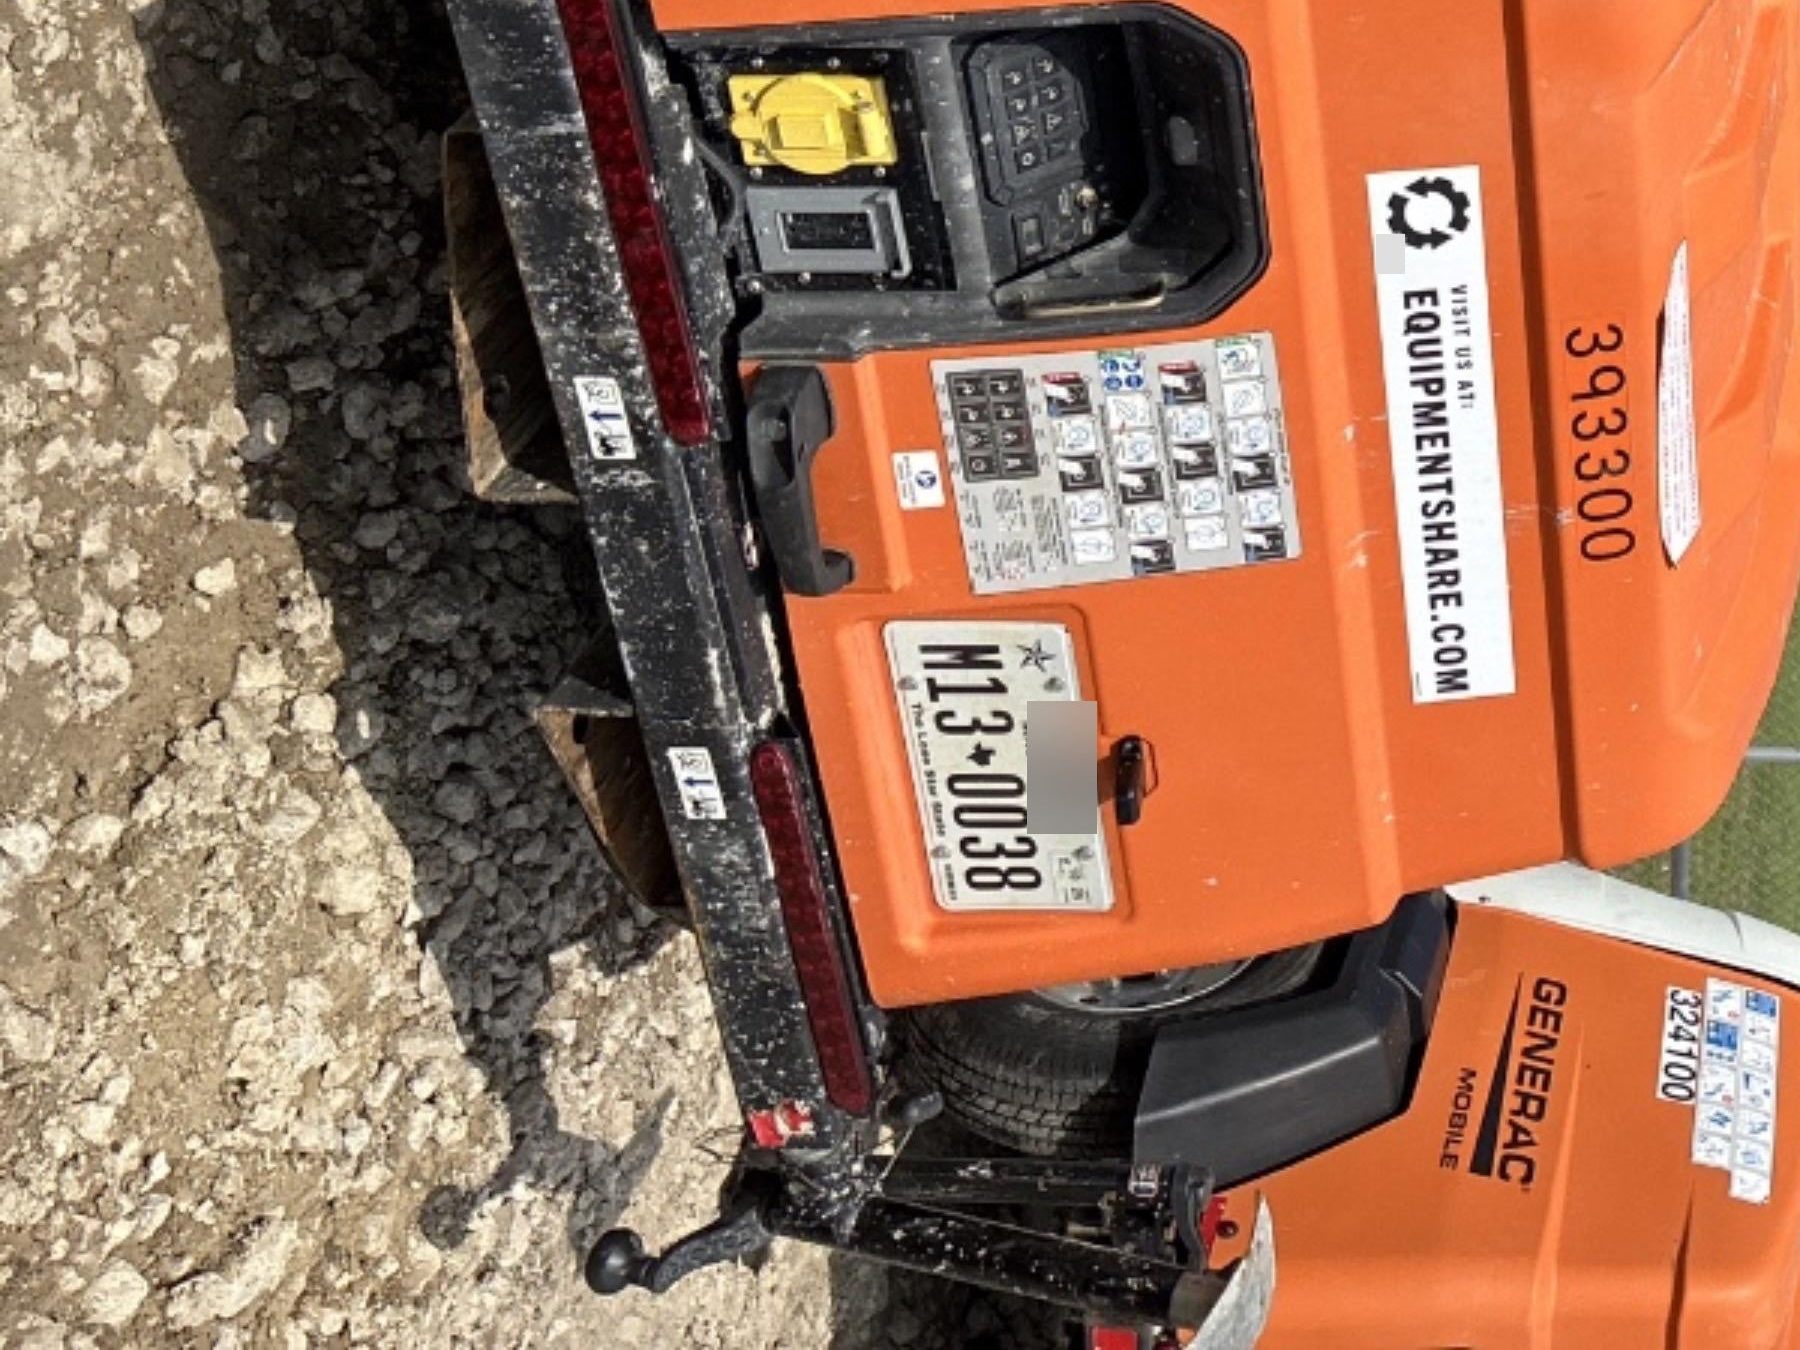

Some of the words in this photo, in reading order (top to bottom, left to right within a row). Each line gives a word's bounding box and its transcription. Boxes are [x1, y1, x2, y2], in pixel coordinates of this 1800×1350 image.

[1450, 284, 1471, 337] VISIT
[1455, 347, 1473, 370] US
[1457, 380, 1475, 410] AT:
[1564, 323, 1636, 562] 393300
[1403, 289, 1470, 694] EQUIPMENTSHARE.COM
[1498, 977, 1567, 1185] GENERAC
[1661, 990, 1701, 1102] 324100
[1439, 1068, 1477, 1170] MOBILE
